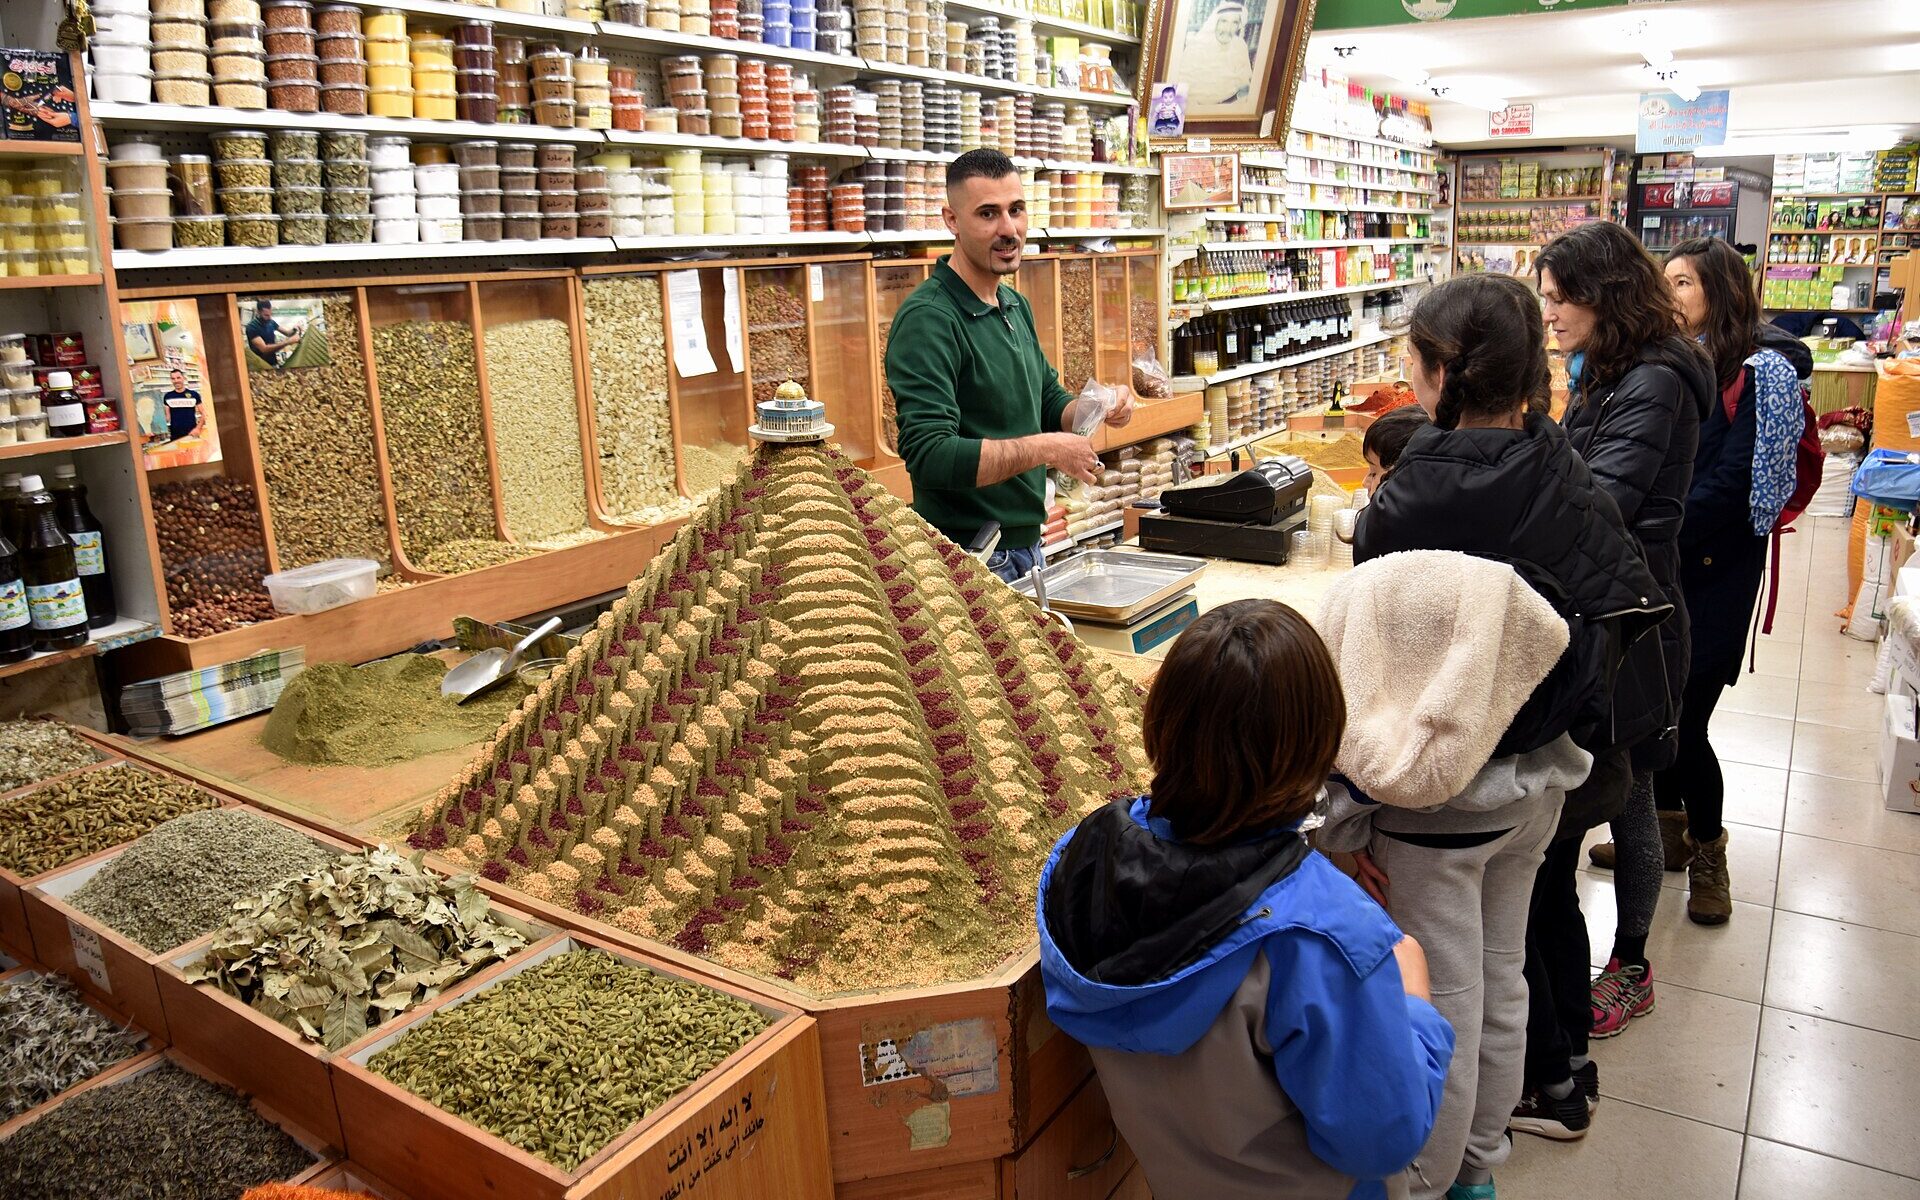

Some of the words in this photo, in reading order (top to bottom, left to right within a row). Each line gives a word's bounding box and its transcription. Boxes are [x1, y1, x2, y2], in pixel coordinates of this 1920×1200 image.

[742, 1092, 752, 1113] لا
[719, 1105, 739, 1132] إله
[696, 1124, 714, 1148] إلا
[667, 1136, 692, 1174] أنت
[703, 1148, 722, 1174] كنت
[688, 1169, 701, 1190] من
